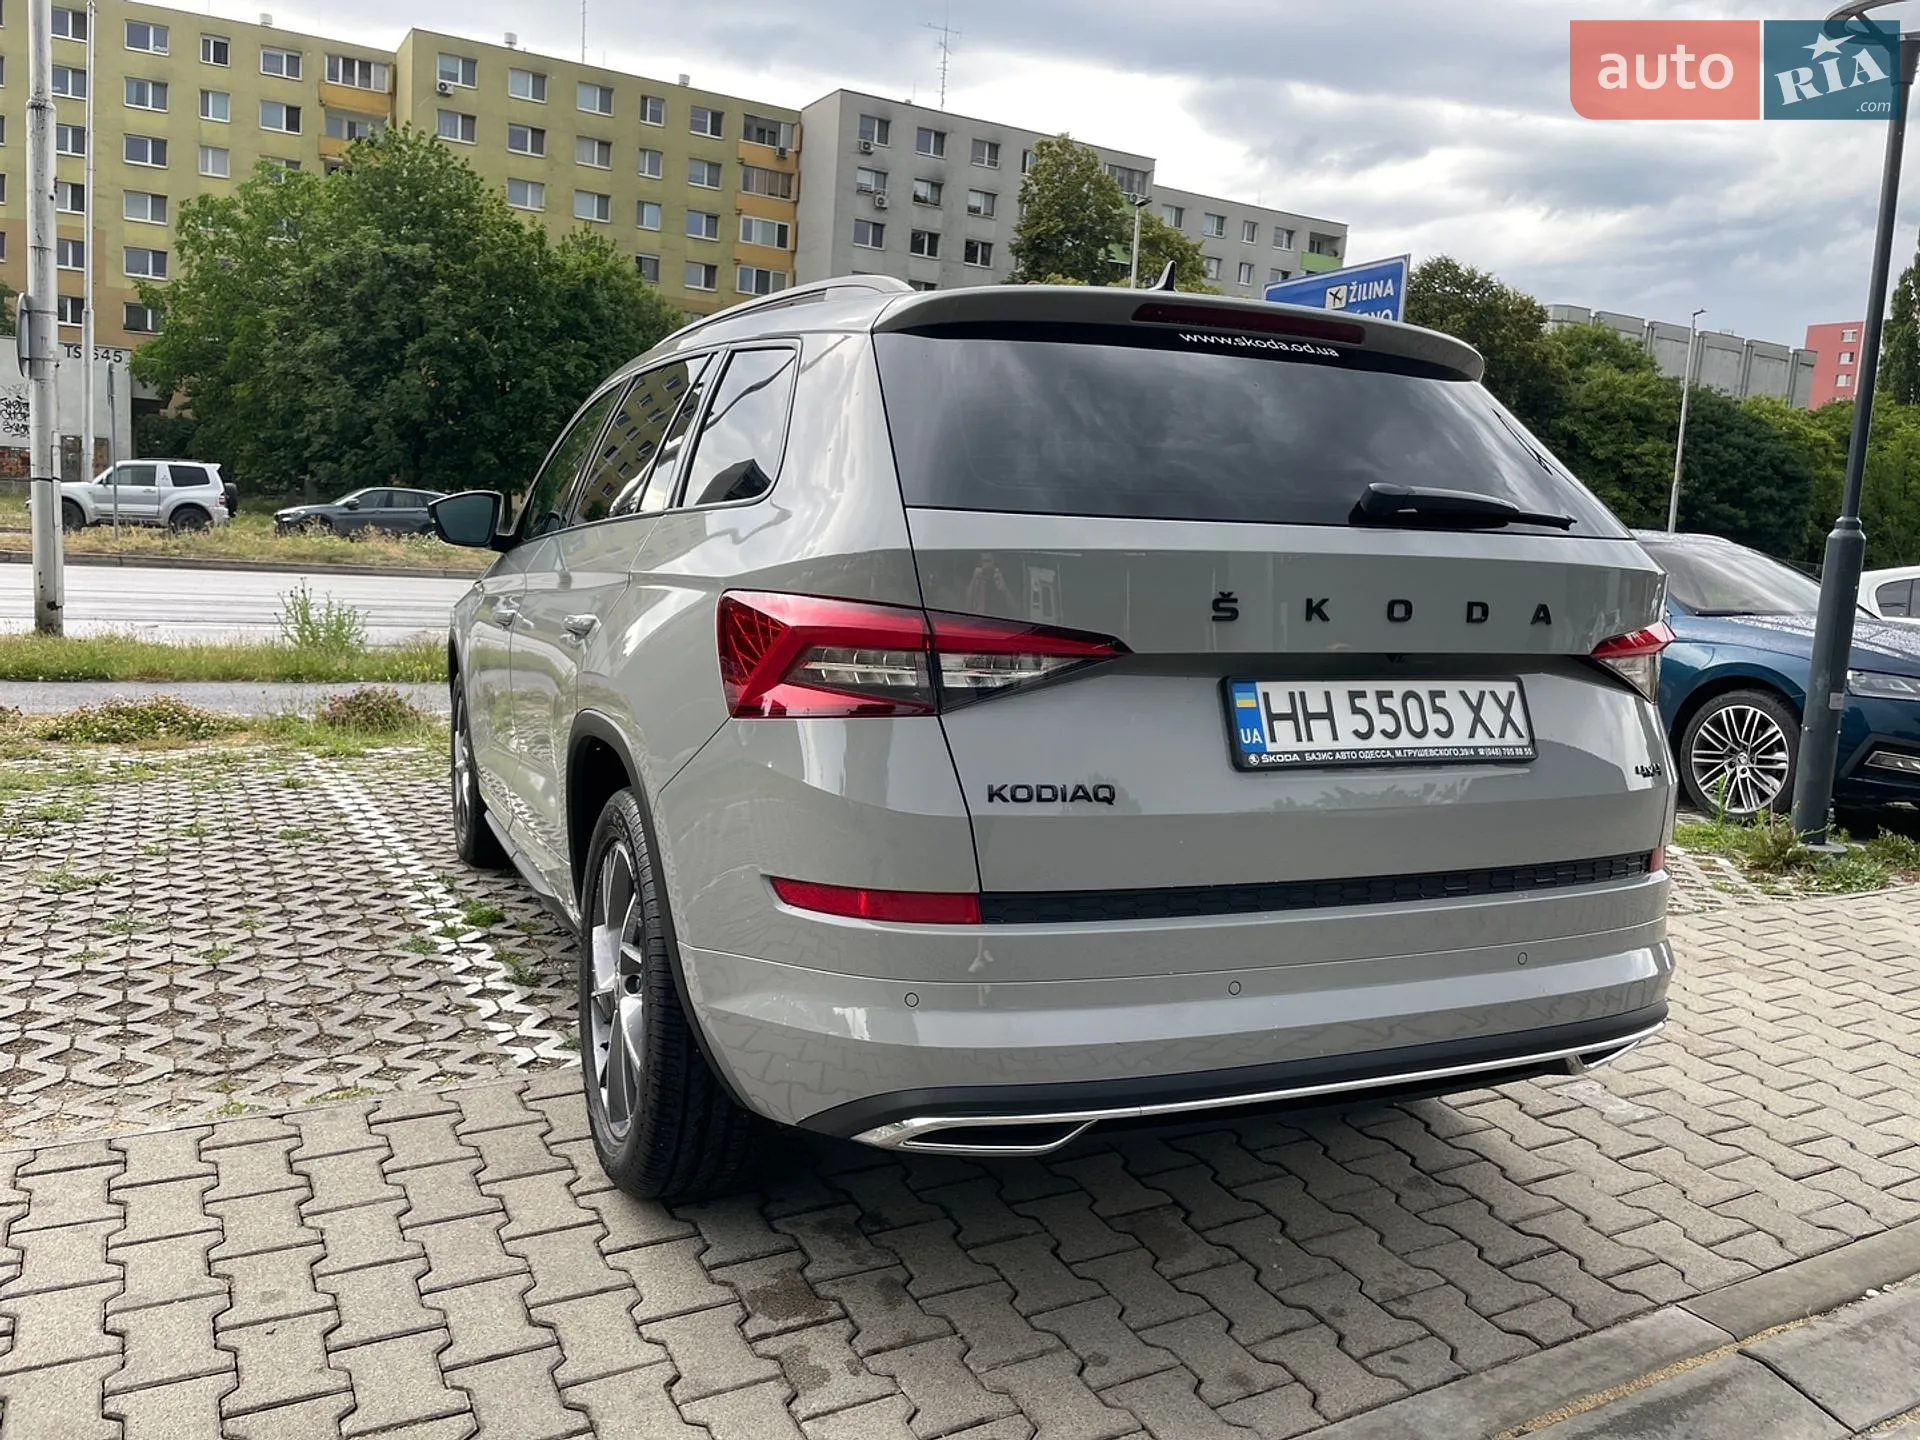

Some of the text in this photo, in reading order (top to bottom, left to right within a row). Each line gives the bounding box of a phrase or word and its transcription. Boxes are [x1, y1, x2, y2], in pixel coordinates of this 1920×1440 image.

[1348, 278, 1395, 303] ŽILINA
[1178, 331, 1340, 358] www.skoda.od.ua
[1211, 591, 1553, 626] ŠKODA
[1262, 689, 1525, 743] HH 5505 XX
[1240, 727, 1263, 745] UA
[1304, 752, 1333, 762] БАЗИС
[1335, 750, 1358, 760] АВТО
[987, 783, 1116, 806] KODIAQ
